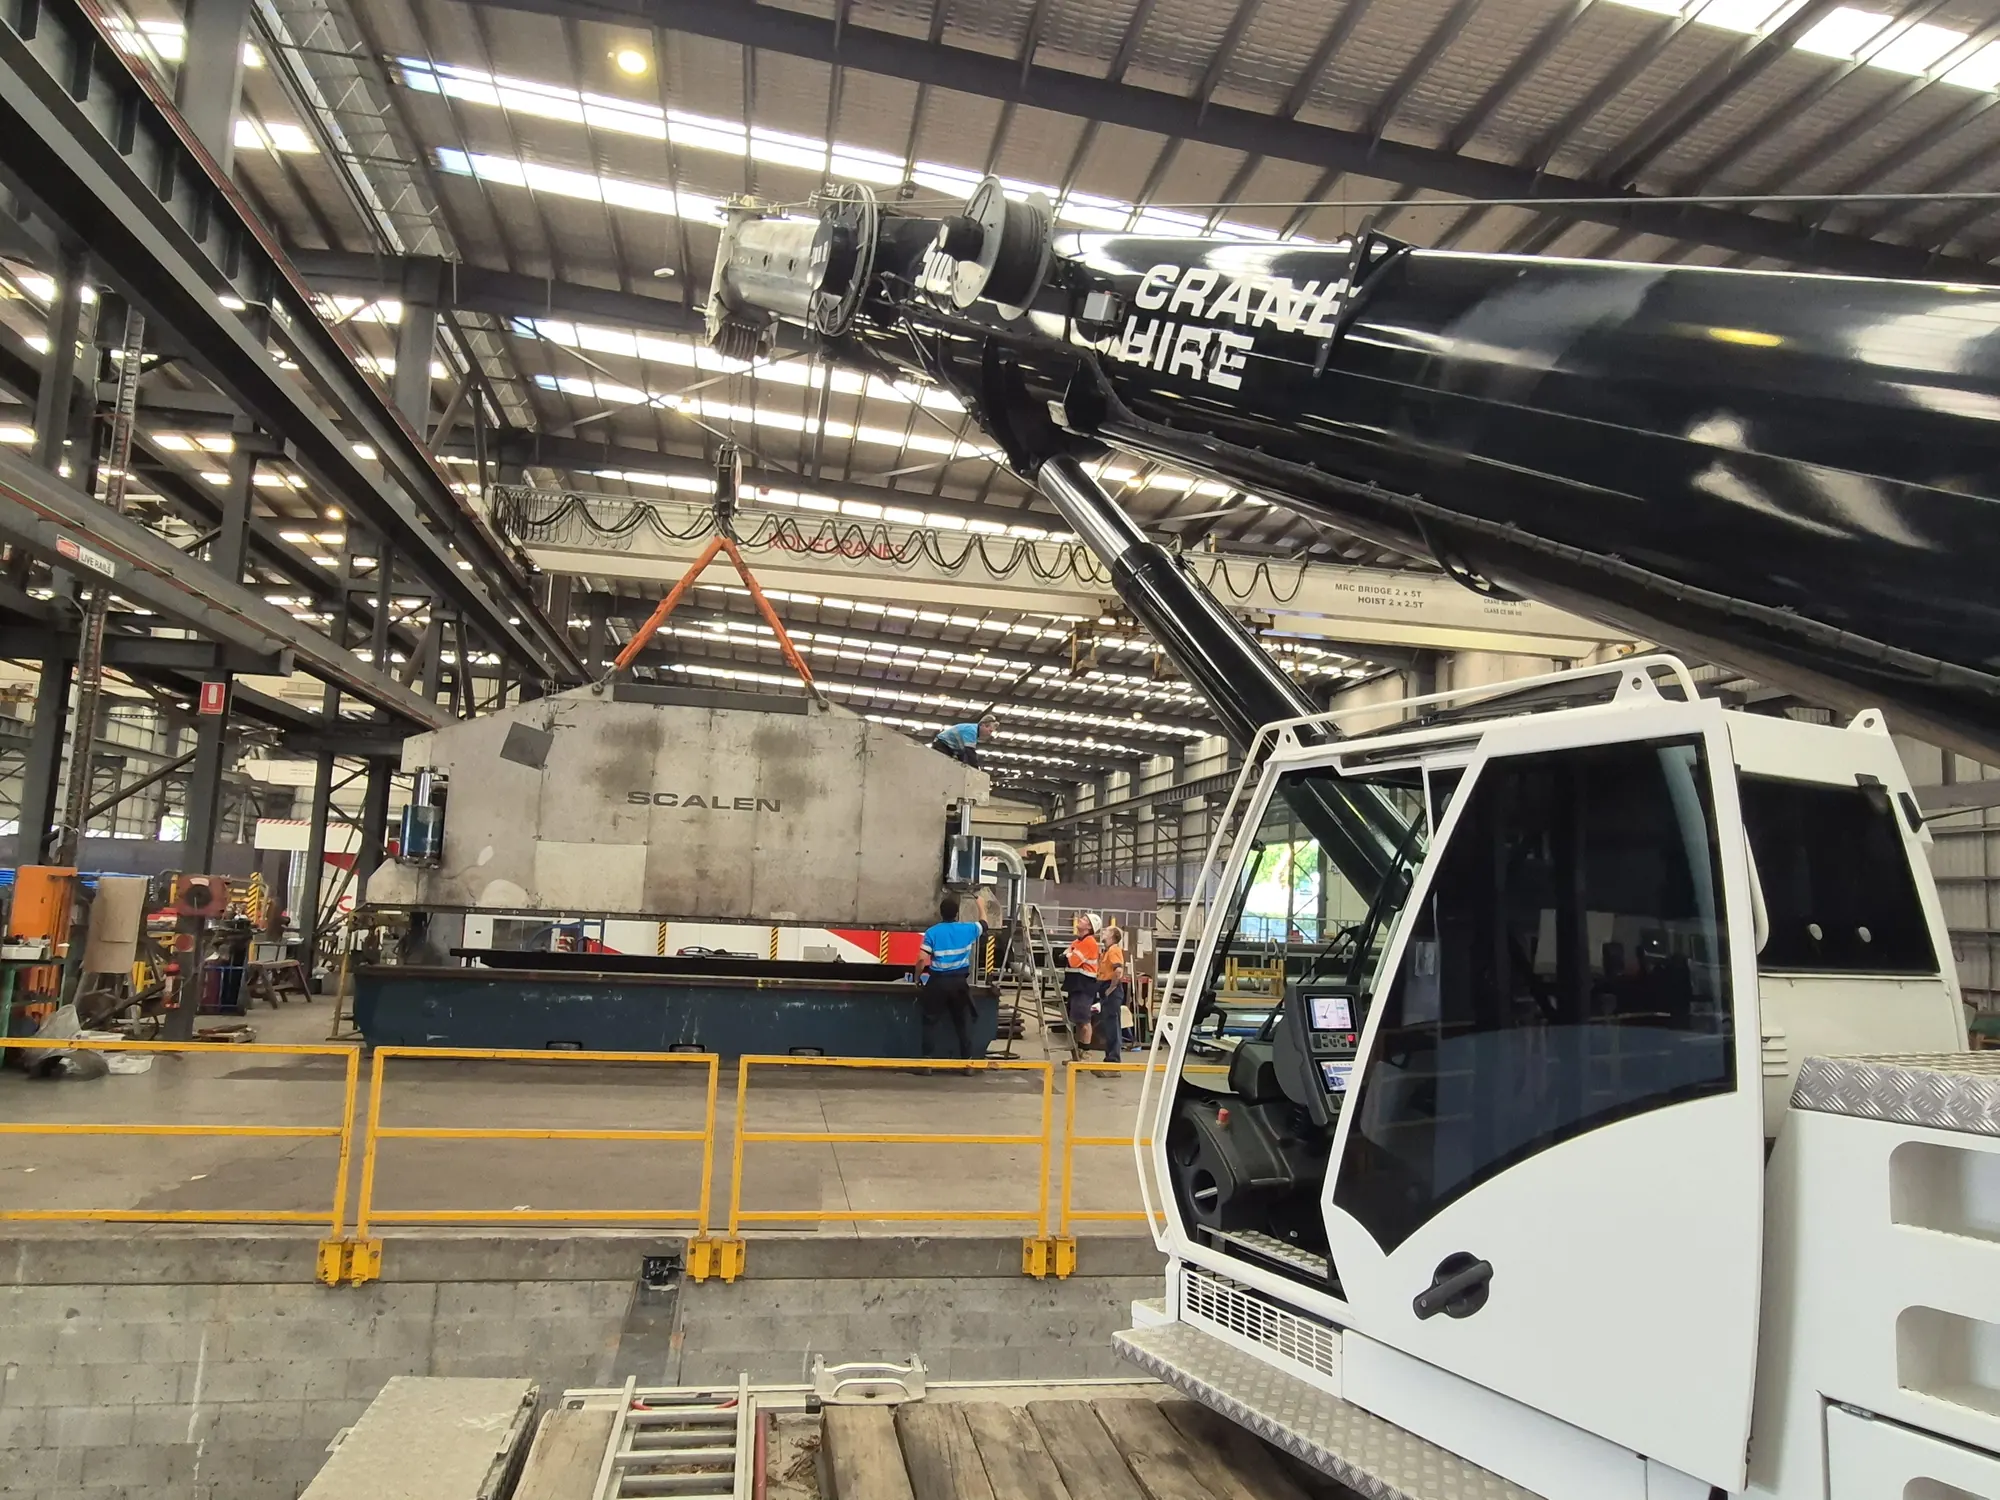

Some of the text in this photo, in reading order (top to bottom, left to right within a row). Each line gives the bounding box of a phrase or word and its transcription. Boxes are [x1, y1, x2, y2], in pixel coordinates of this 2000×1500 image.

[1135, 264, 1362, 338] CRANE
[1117, 315, 1255, 391] HIRE
[768, 532, 906, 560] KONECRANES
[1335, 583, 1355, 592] MRC
[1358, 585, 1392, 595] BRIDGE
[1395, 588, 1400, 596] 2
[1411, 590, 1422, 598] 5T
[1357, 596, 1386, 605] HOIST
[1405, 600, 1424, 609] 2.5T
[627, 791, 781, 813] SCALEN
